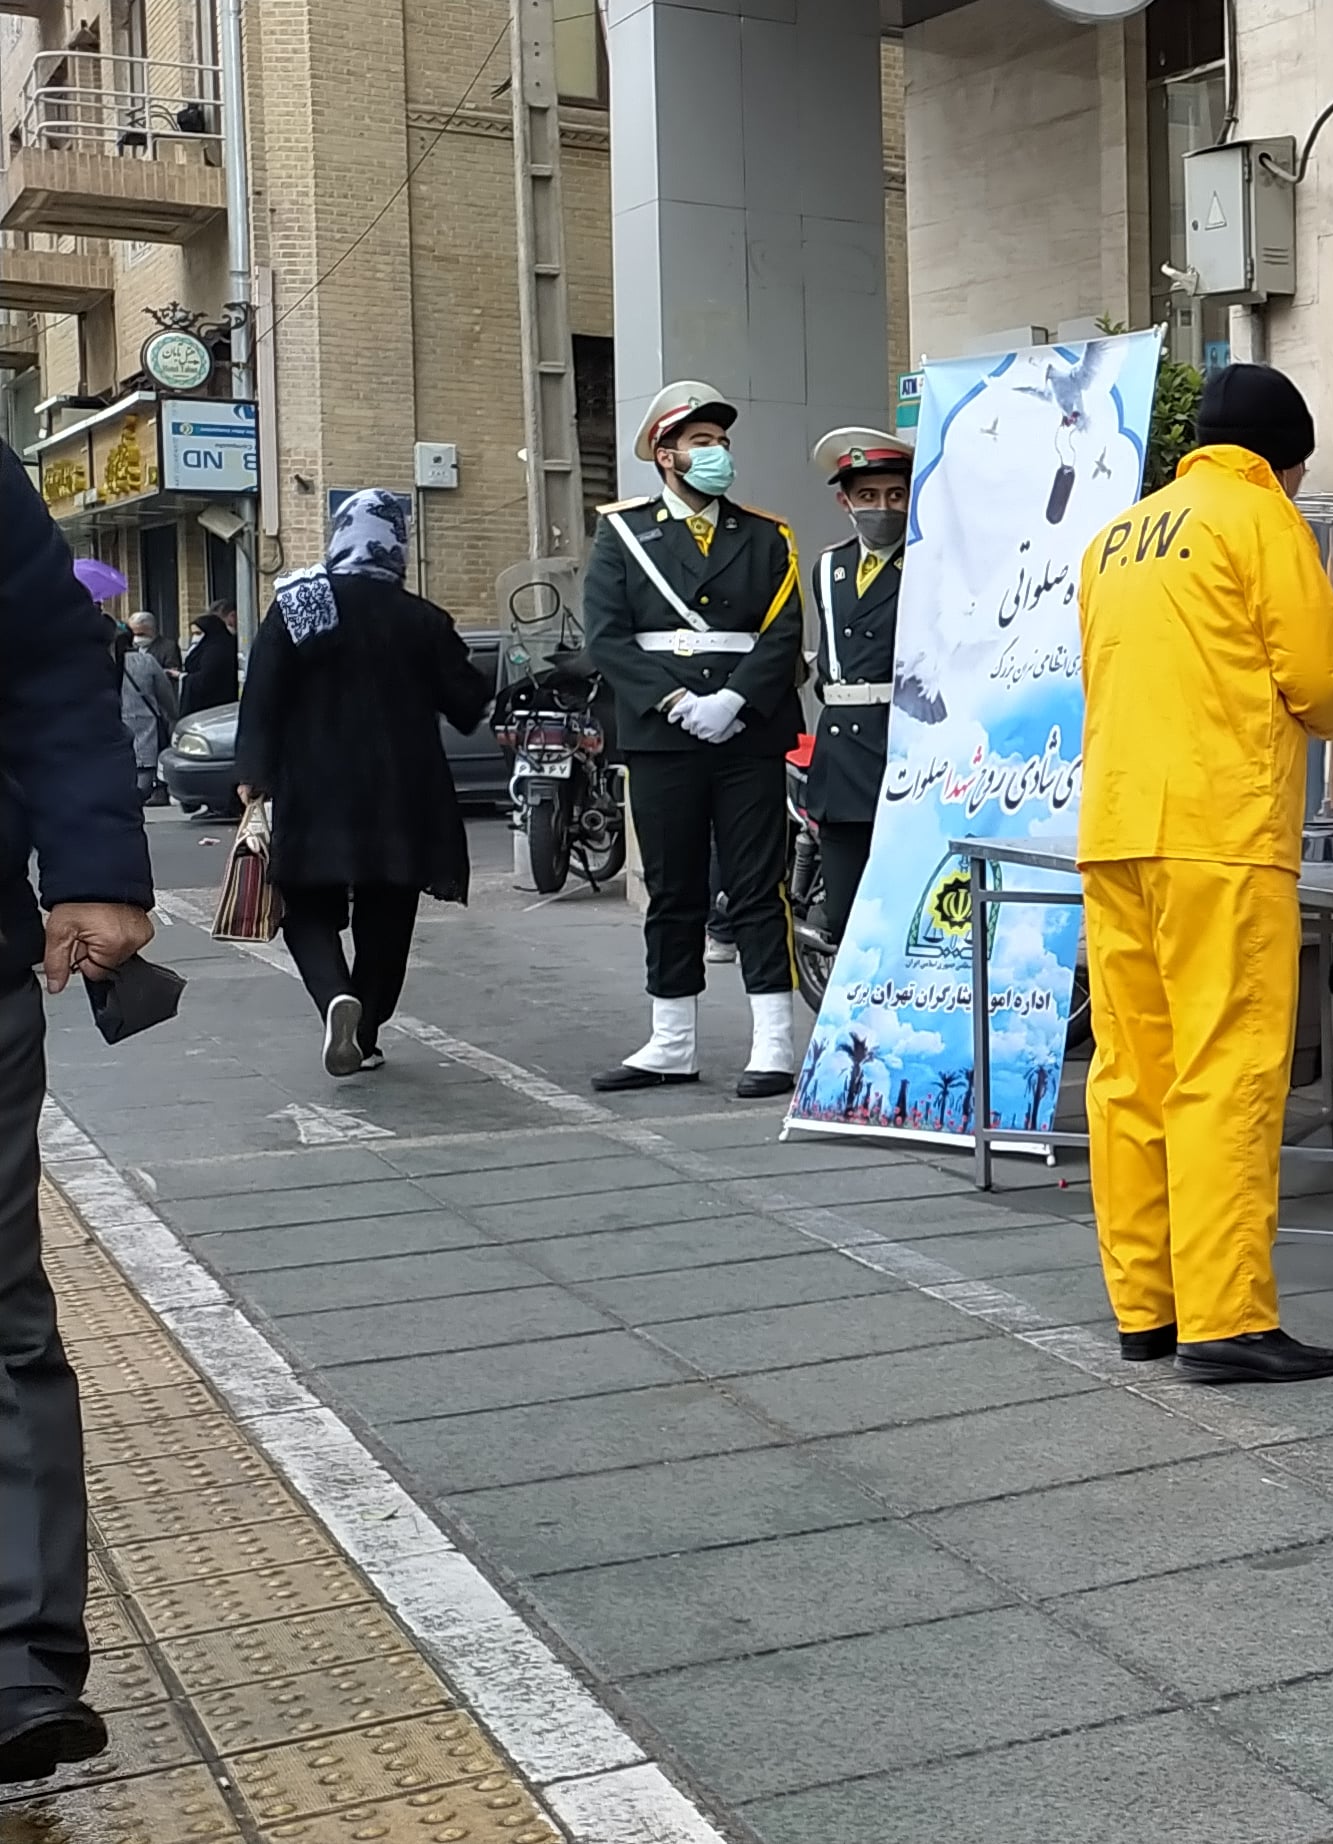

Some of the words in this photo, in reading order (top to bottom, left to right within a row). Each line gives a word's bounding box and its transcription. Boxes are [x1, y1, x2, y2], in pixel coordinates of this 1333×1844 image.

[1099, 507, 1192, 574] P.W.
[998, 540, 1069, 628] صلواتی
[989, 636, 1020, 690] بزرگ
[1032, 645, 1068, 679] انتظامی
[885, 757, 948, 802] صلوات
[944, 745, 982, 801] شهدا
[968, 767, 1007, 814] روح
[1004, 730, 1058, 810] شادی
[870, 981, 915, 1007] تهران
[915, 983, 972, 1011] یثارگران
[988, 989, 1012, 1013] امو
[1013, 990, 1051, 1015] اداره
